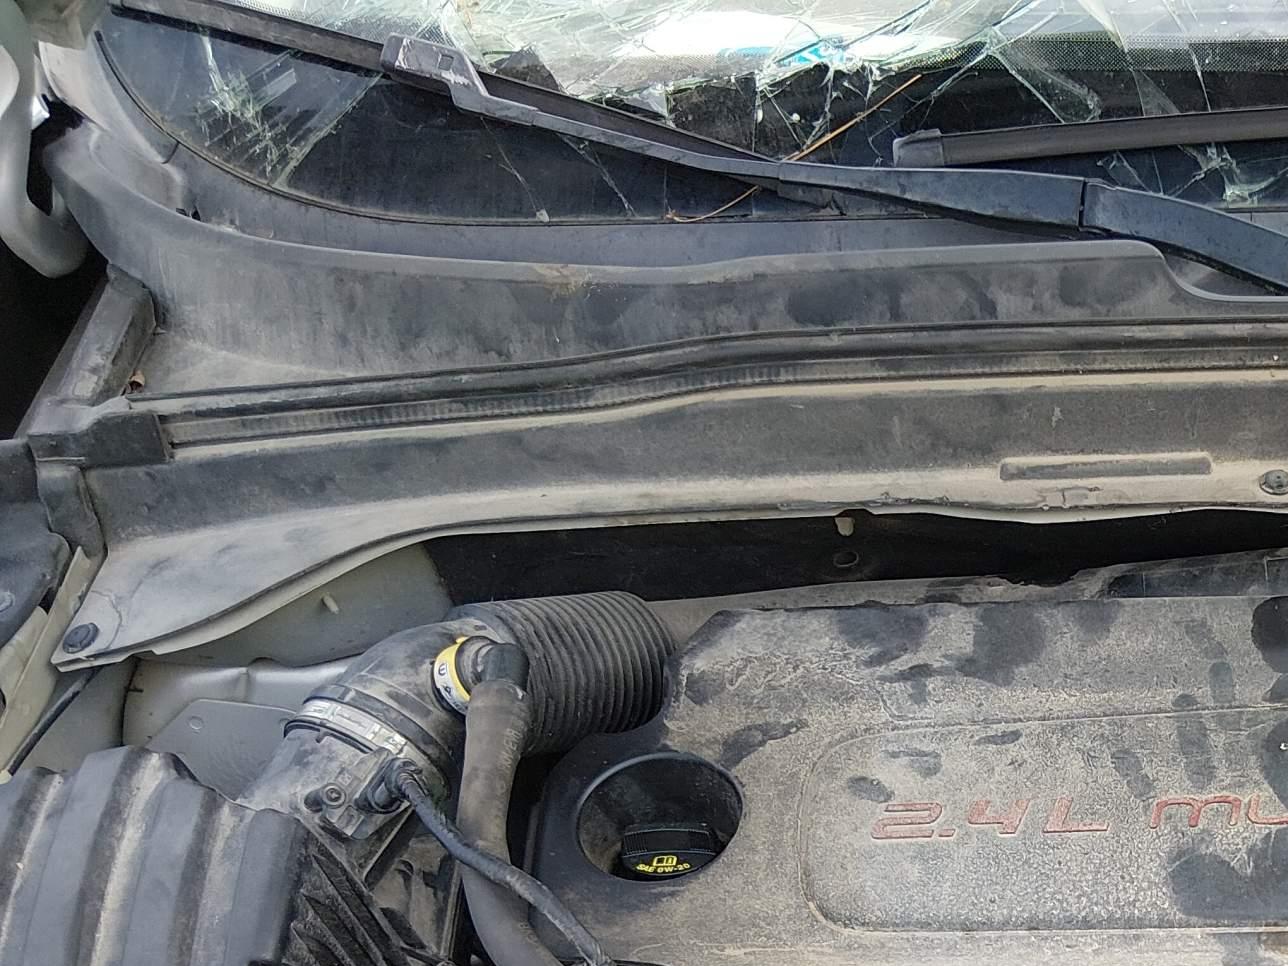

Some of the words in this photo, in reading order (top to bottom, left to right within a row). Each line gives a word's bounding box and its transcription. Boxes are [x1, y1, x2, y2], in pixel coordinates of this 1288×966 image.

[871, 797, 1109, 841] 2.4L
[636, 863, 656, 873] SAE
[657, 863, 691, 873] 0W-20
